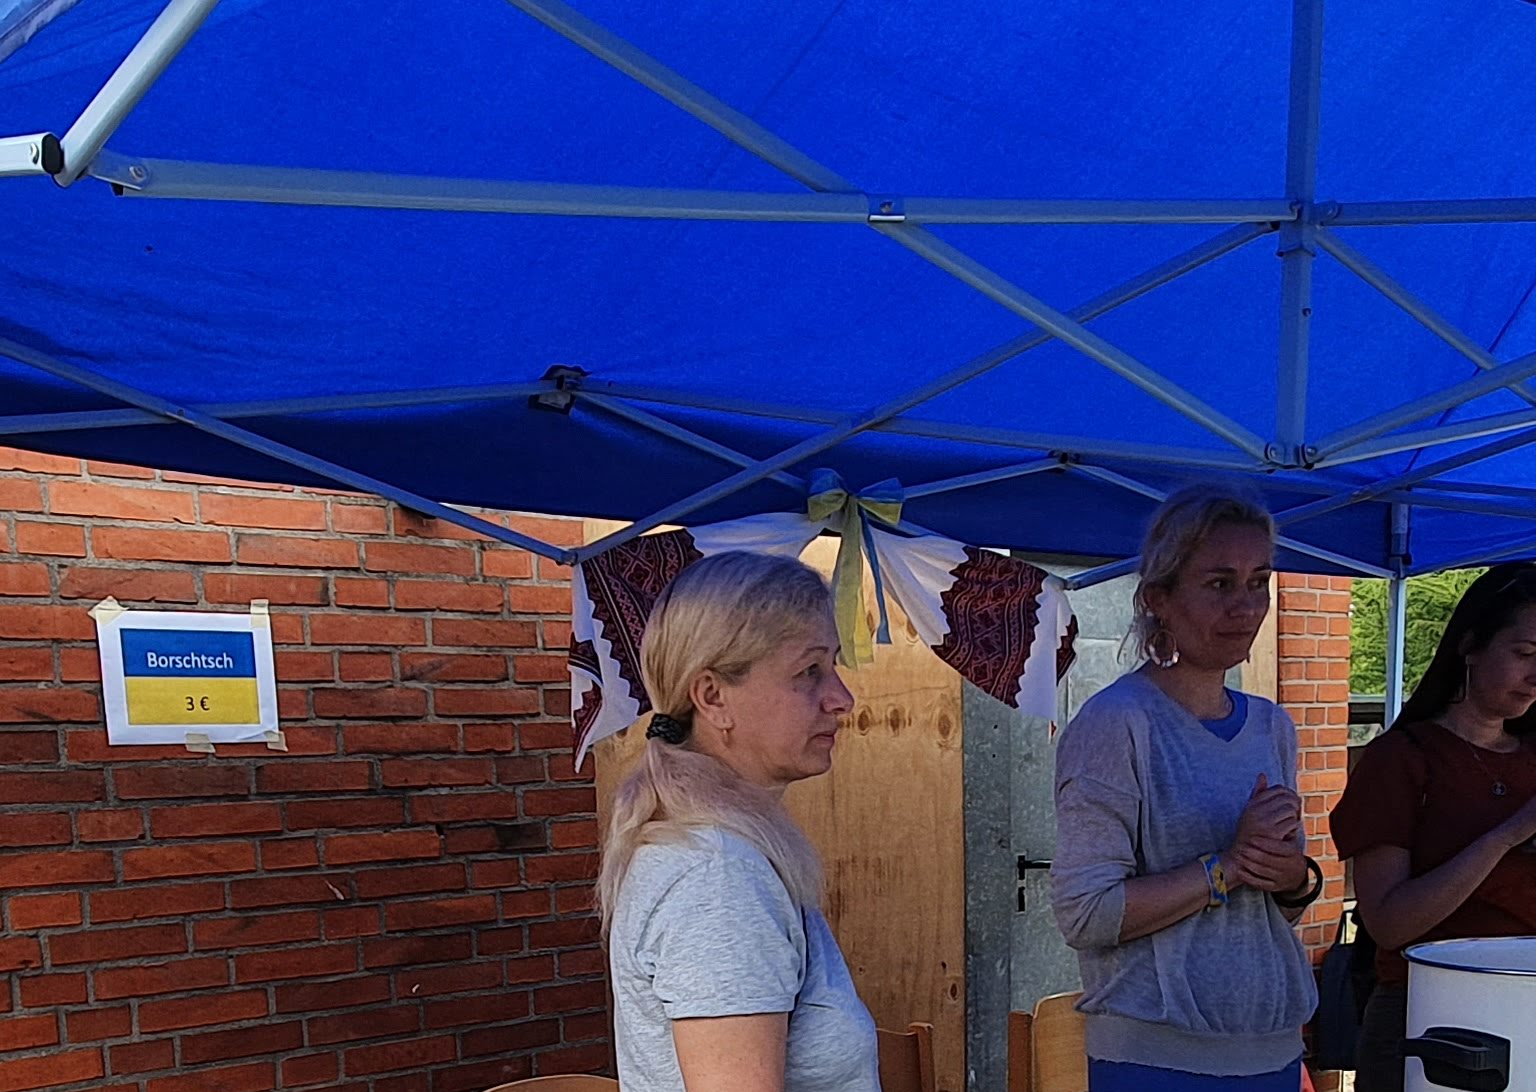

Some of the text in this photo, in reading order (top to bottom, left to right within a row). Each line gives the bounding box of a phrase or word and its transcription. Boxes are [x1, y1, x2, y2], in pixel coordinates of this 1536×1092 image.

[147, 652, 233, 669] Borschtsch
[185, 696, 210, 711] 3 €
